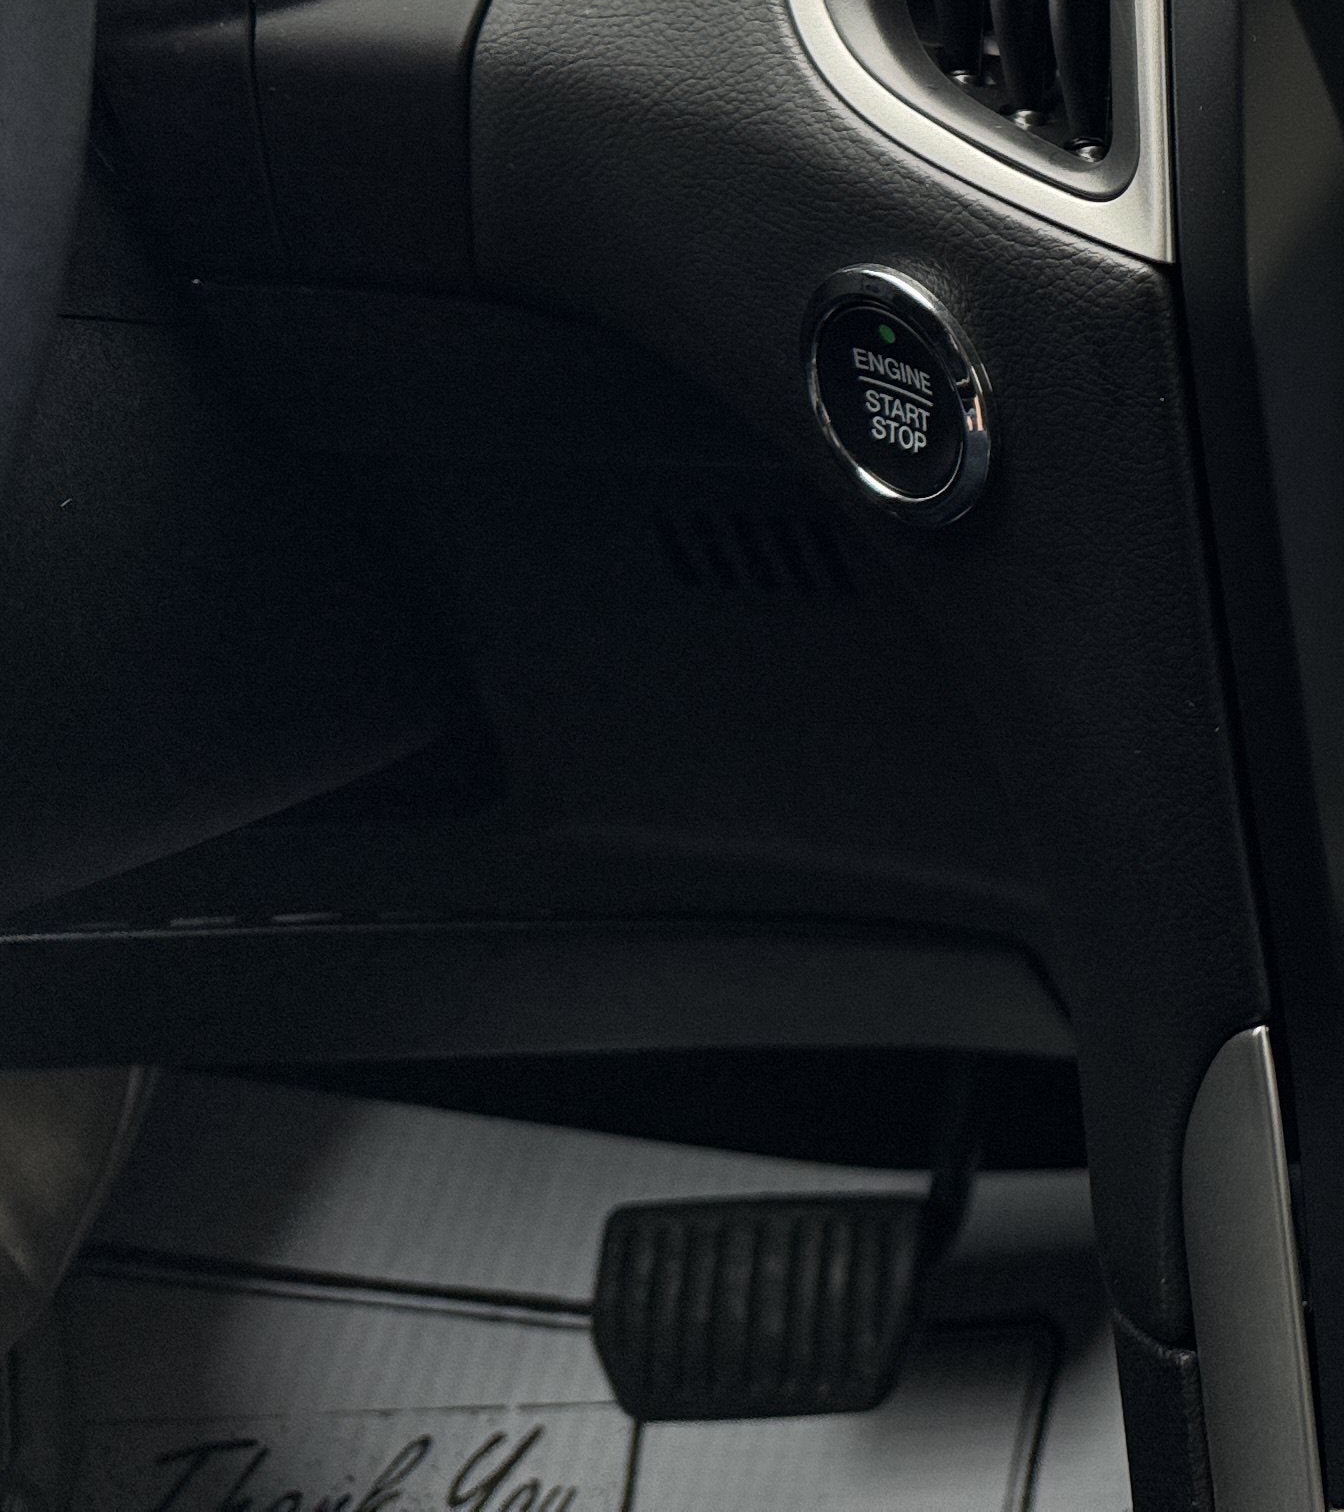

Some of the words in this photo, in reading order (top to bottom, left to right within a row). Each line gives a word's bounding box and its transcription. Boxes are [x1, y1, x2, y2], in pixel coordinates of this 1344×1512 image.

[853, 347, 932, 395] ENGINE
[865, 389, 930, 432] START
[872, 416, 927, 454] STOP
